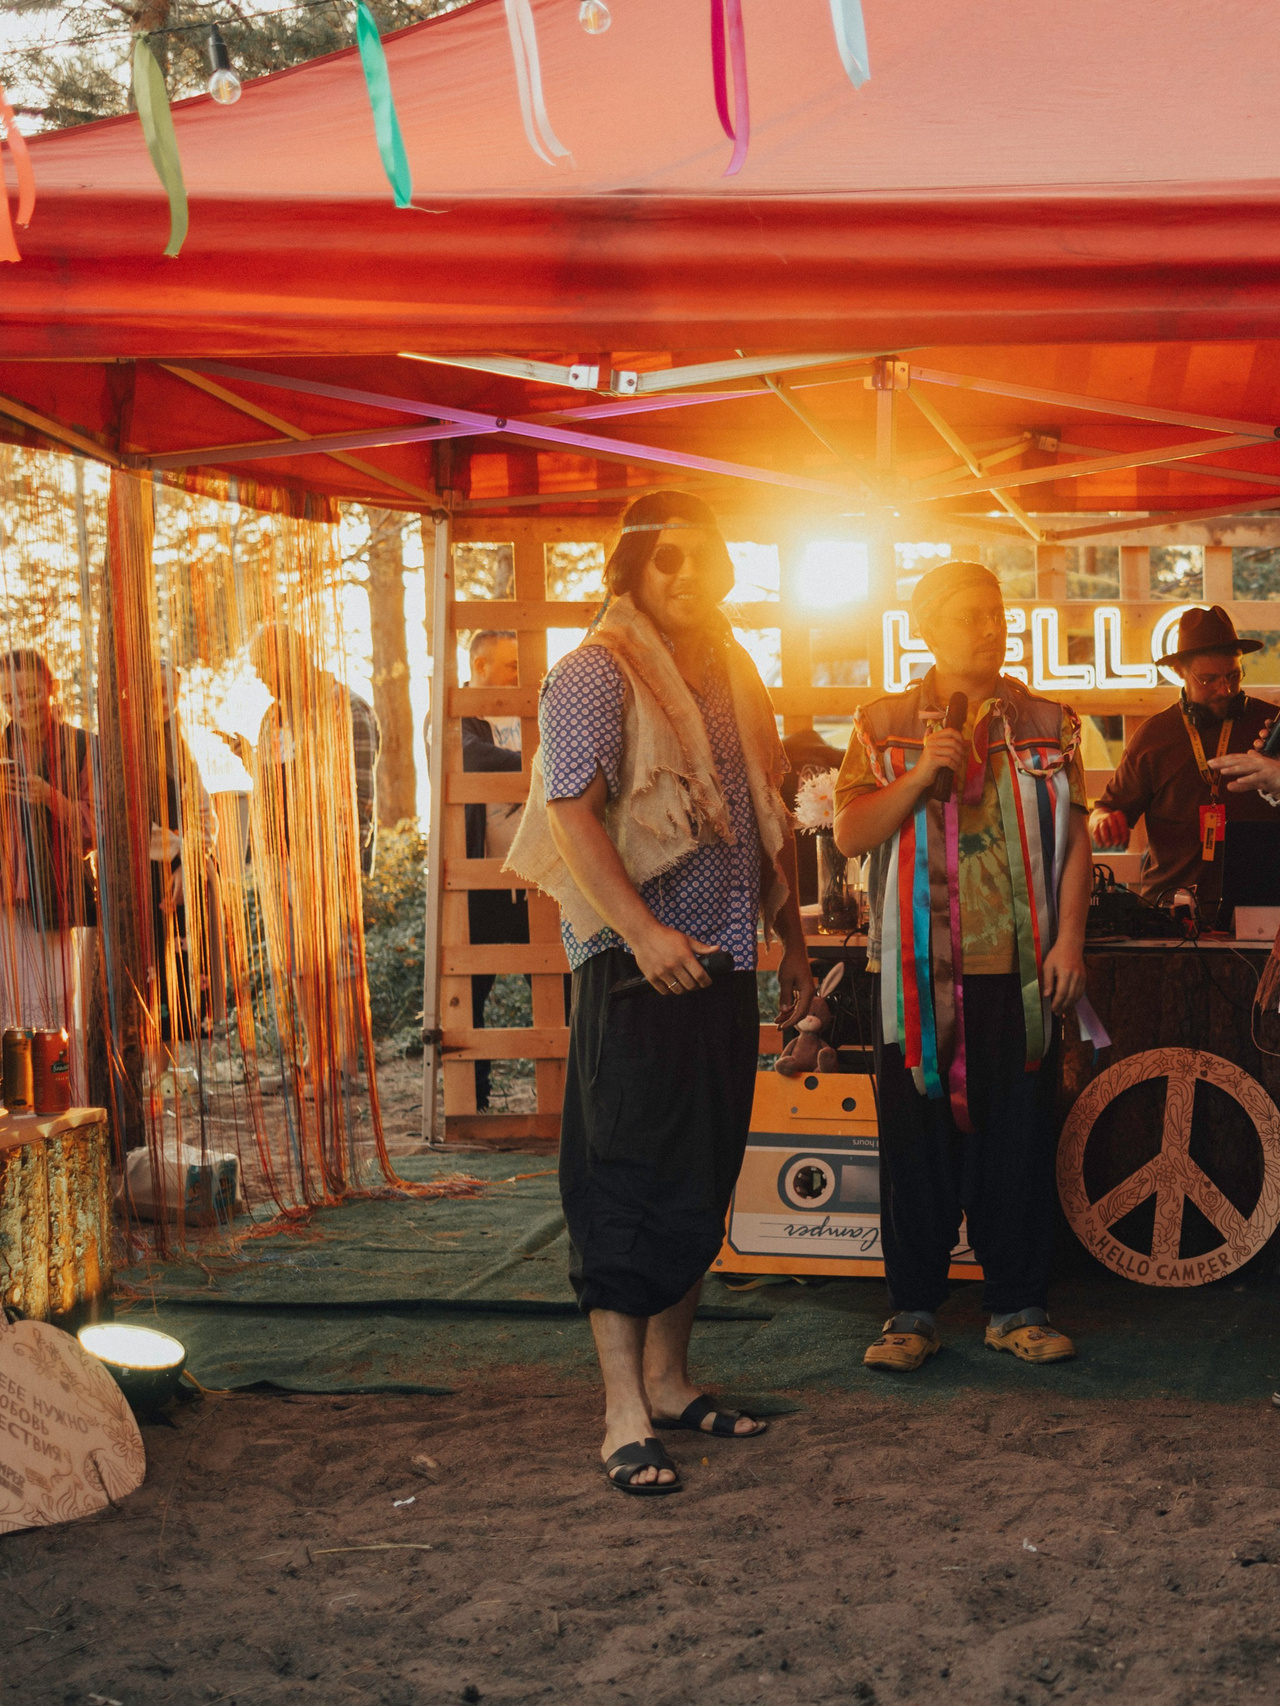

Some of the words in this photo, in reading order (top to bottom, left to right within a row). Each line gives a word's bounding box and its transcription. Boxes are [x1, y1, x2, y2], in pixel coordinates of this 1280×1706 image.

[852, 1139, 875, 1148] hours
[784, 1216, 880, 1252] Camper
[1095, 1235, 1150, 1276] HELLO
[1156, 1252, 1232, 1281] CAMPER
[33, 1395, 89, 1434] НУЖНО
